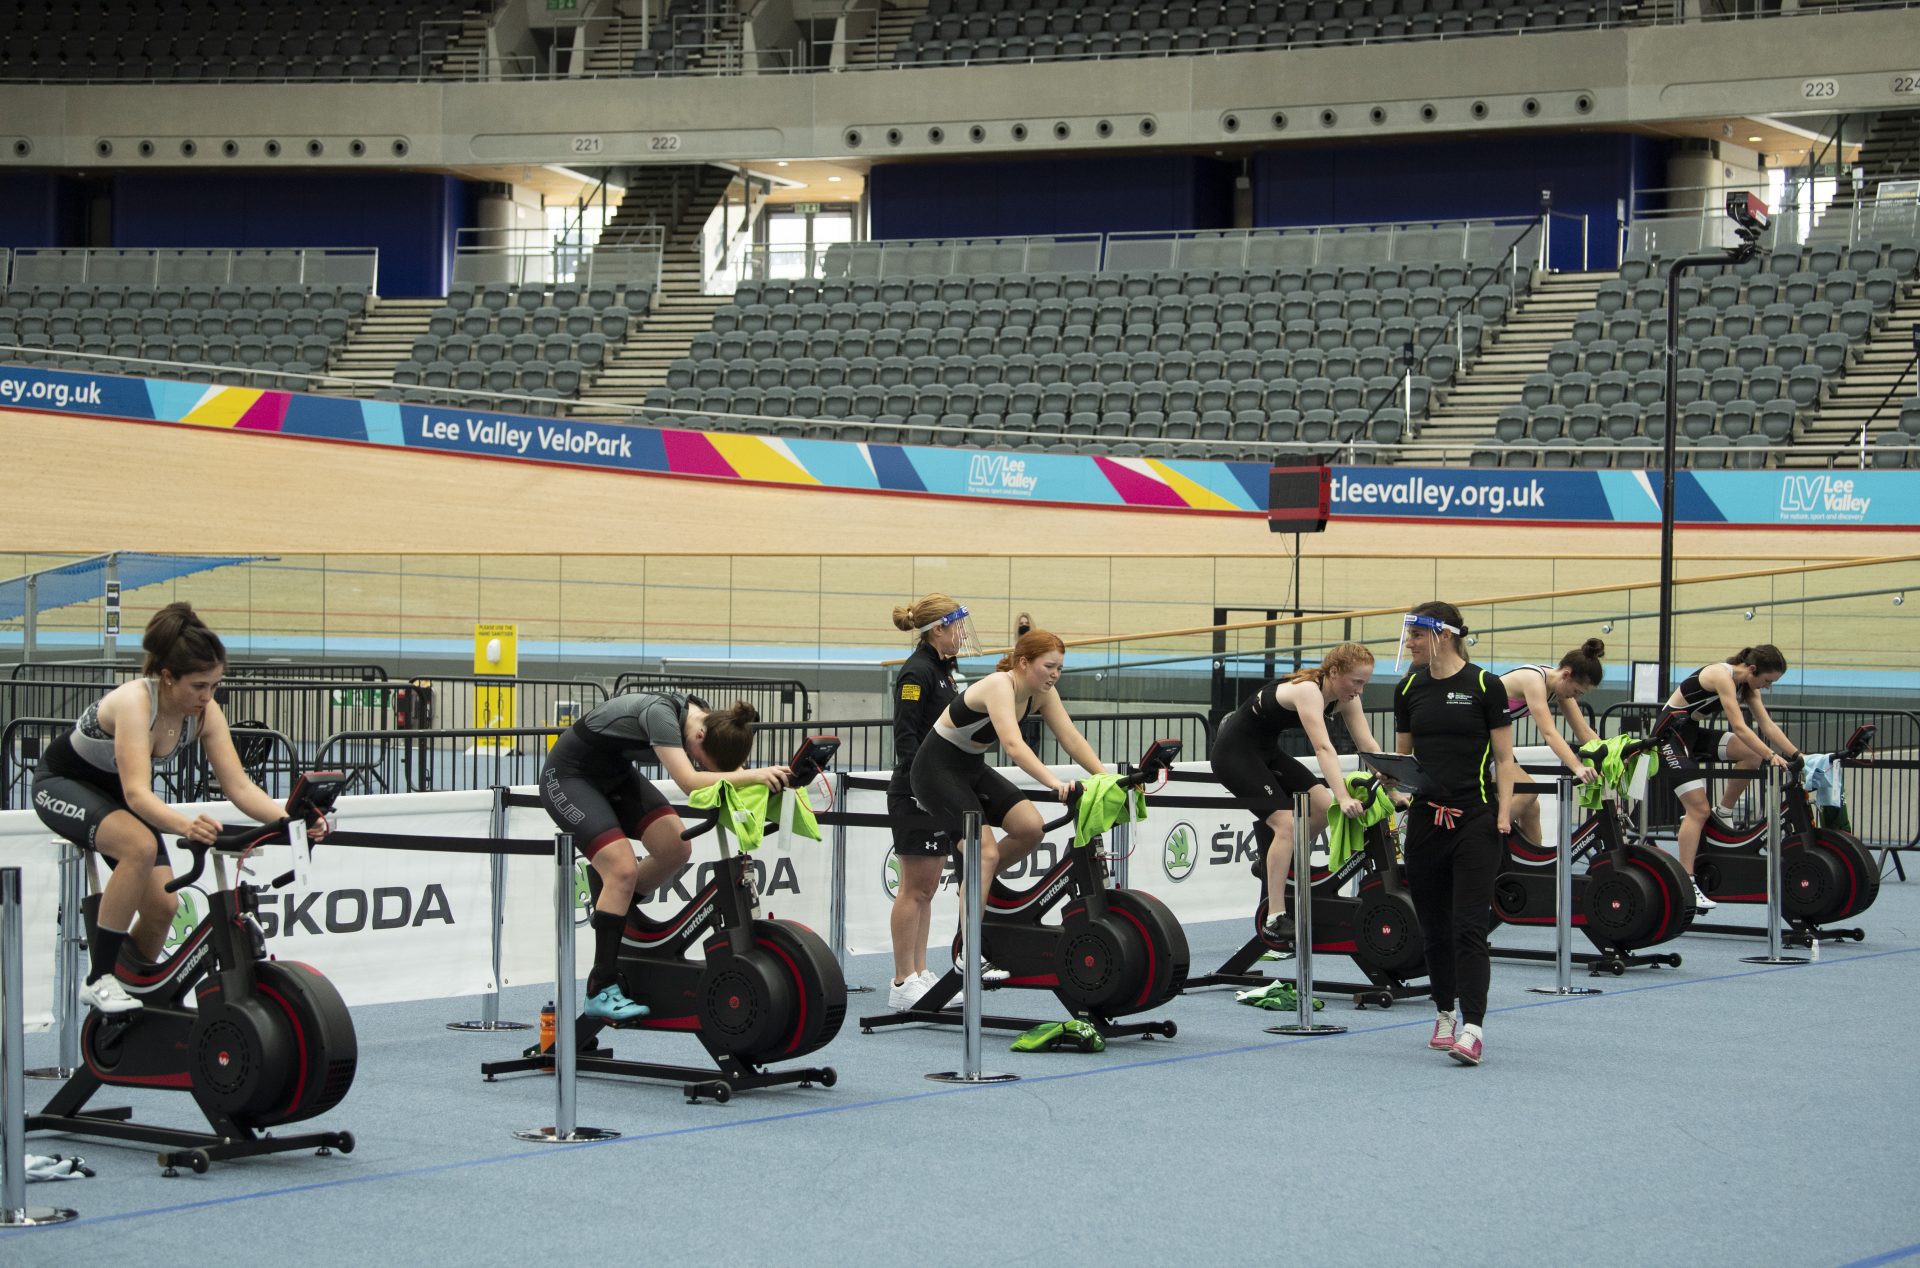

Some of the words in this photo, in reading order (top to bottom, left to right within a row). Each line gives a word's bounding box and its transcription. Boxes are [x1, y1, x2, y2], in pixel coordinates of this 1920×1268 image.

[1805, 82, 1835, 97] 223
[575, 138, 599, 151] 221
[652, 136, 677, 150] 222
[0, 379, 102, 407] ey.org.uk
[421, 414, 460, 441] Lee
[466, 418, 532, 454] Valley
[538, 426, 632, 458] VeloPark
[1002, 456, 1026, 472] Lee
[1001, 471, 1038, 491] Valley
[1824, 475, 1854, 493] Lee
[1330, 475, 1545, 514] tleevalley.org.uk
[1823, 494, 1871, 514] Valley
[35, 789, 86, 821] ŠKODA
[545, 768, 586, 825] HUUB
[681, 903, 714, 939] wattbike
[176, 943, 209, 983] wattbike
